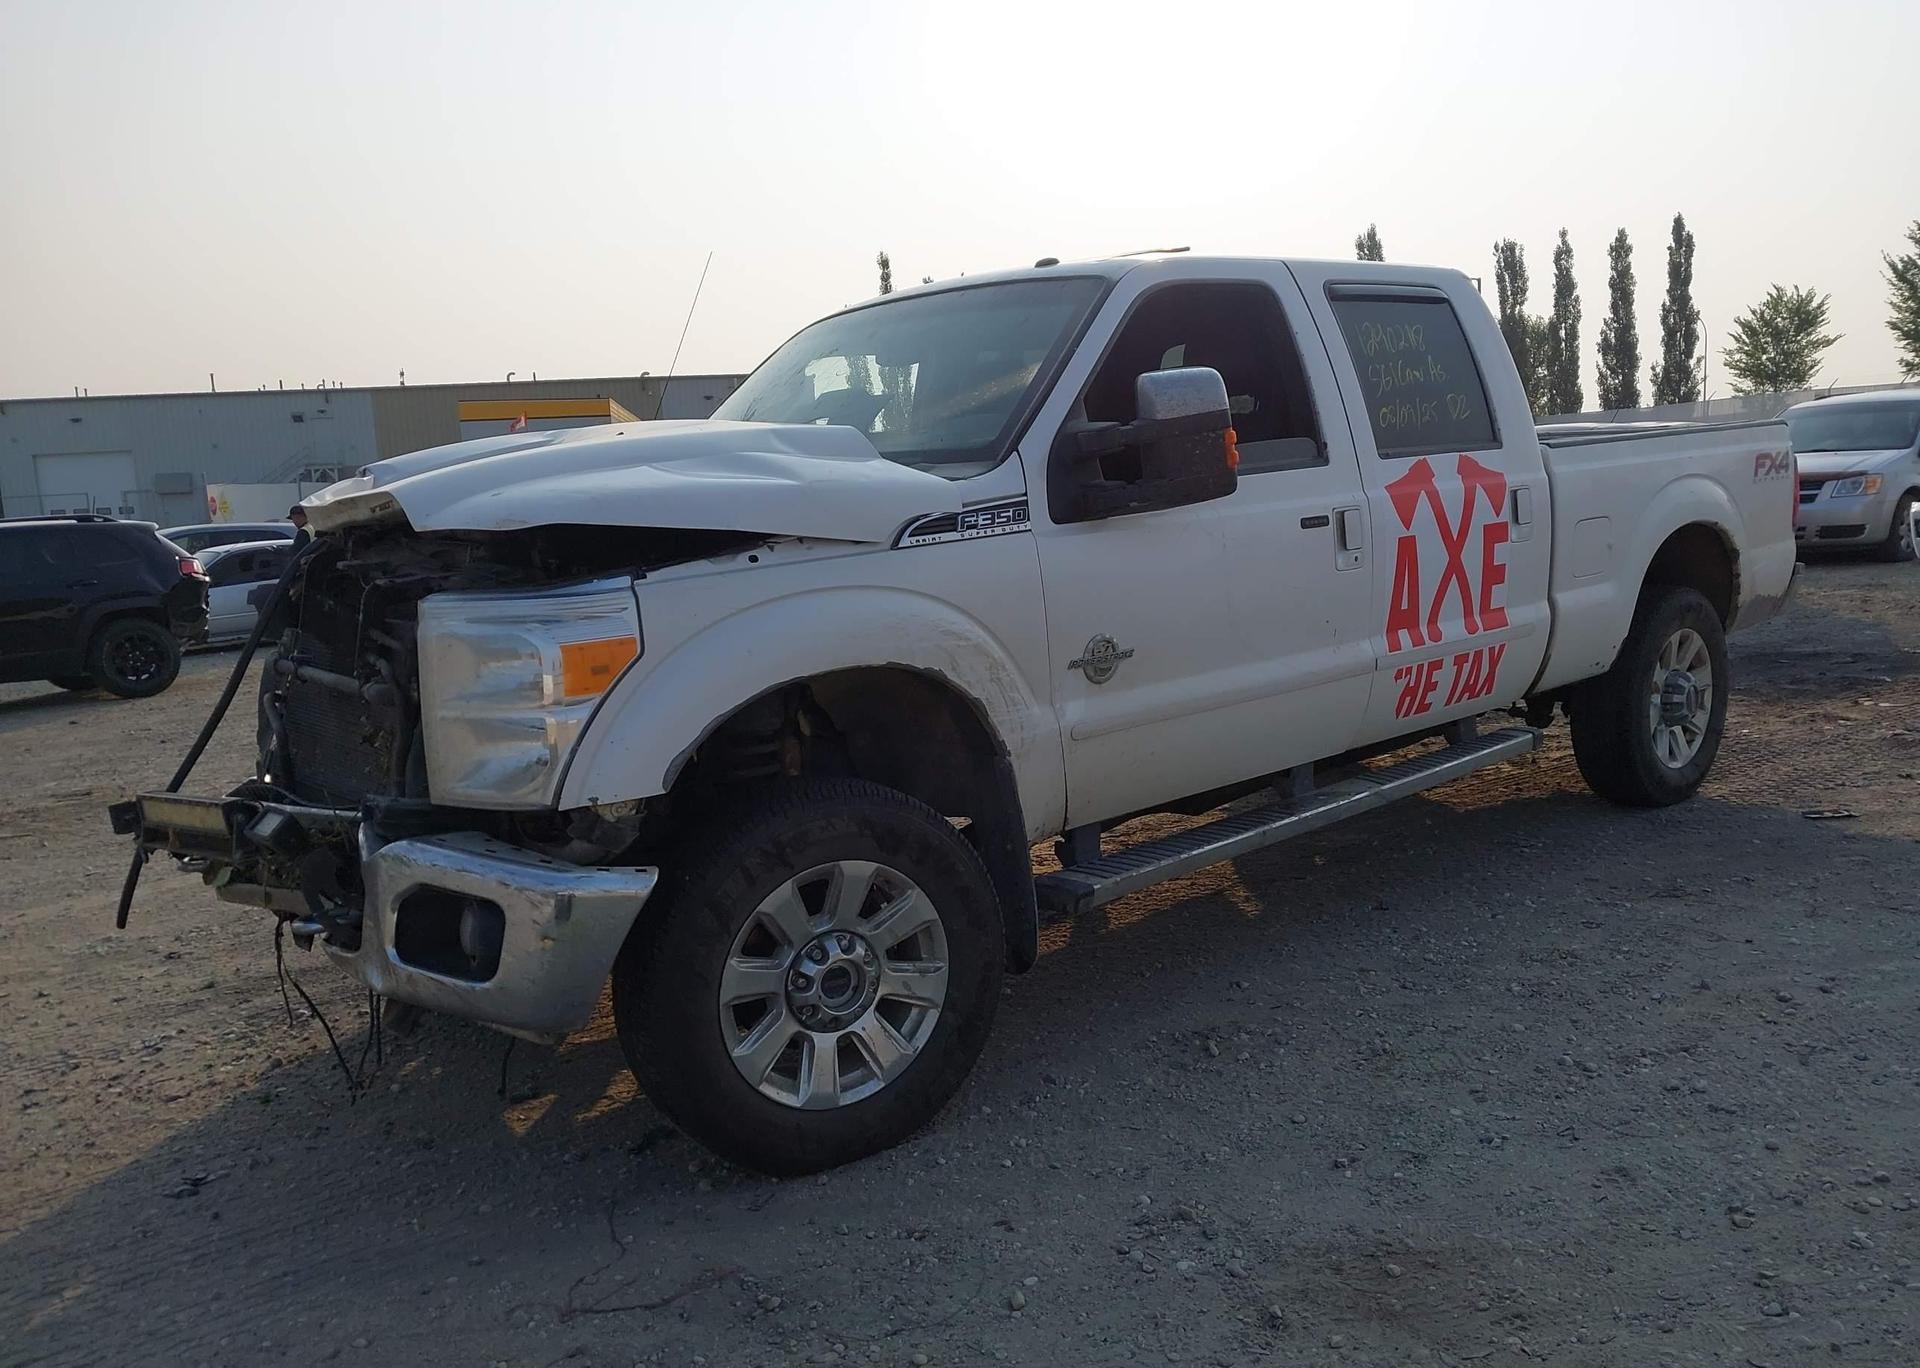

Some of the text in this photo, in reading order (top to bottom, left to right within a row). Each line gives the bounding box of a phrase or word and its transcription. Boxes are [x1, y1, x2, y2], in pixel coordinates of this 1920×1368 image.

[1754, 448, 1790, 478] FX4
[957, 506, 1028, 532] F-350
[960, 528, 996, 538] SUPER
[1001, 523, 1029, 533] DUTY
[1385, 453, 1510, 653] AXE
[1444, 643, 1506, 707] TAX
